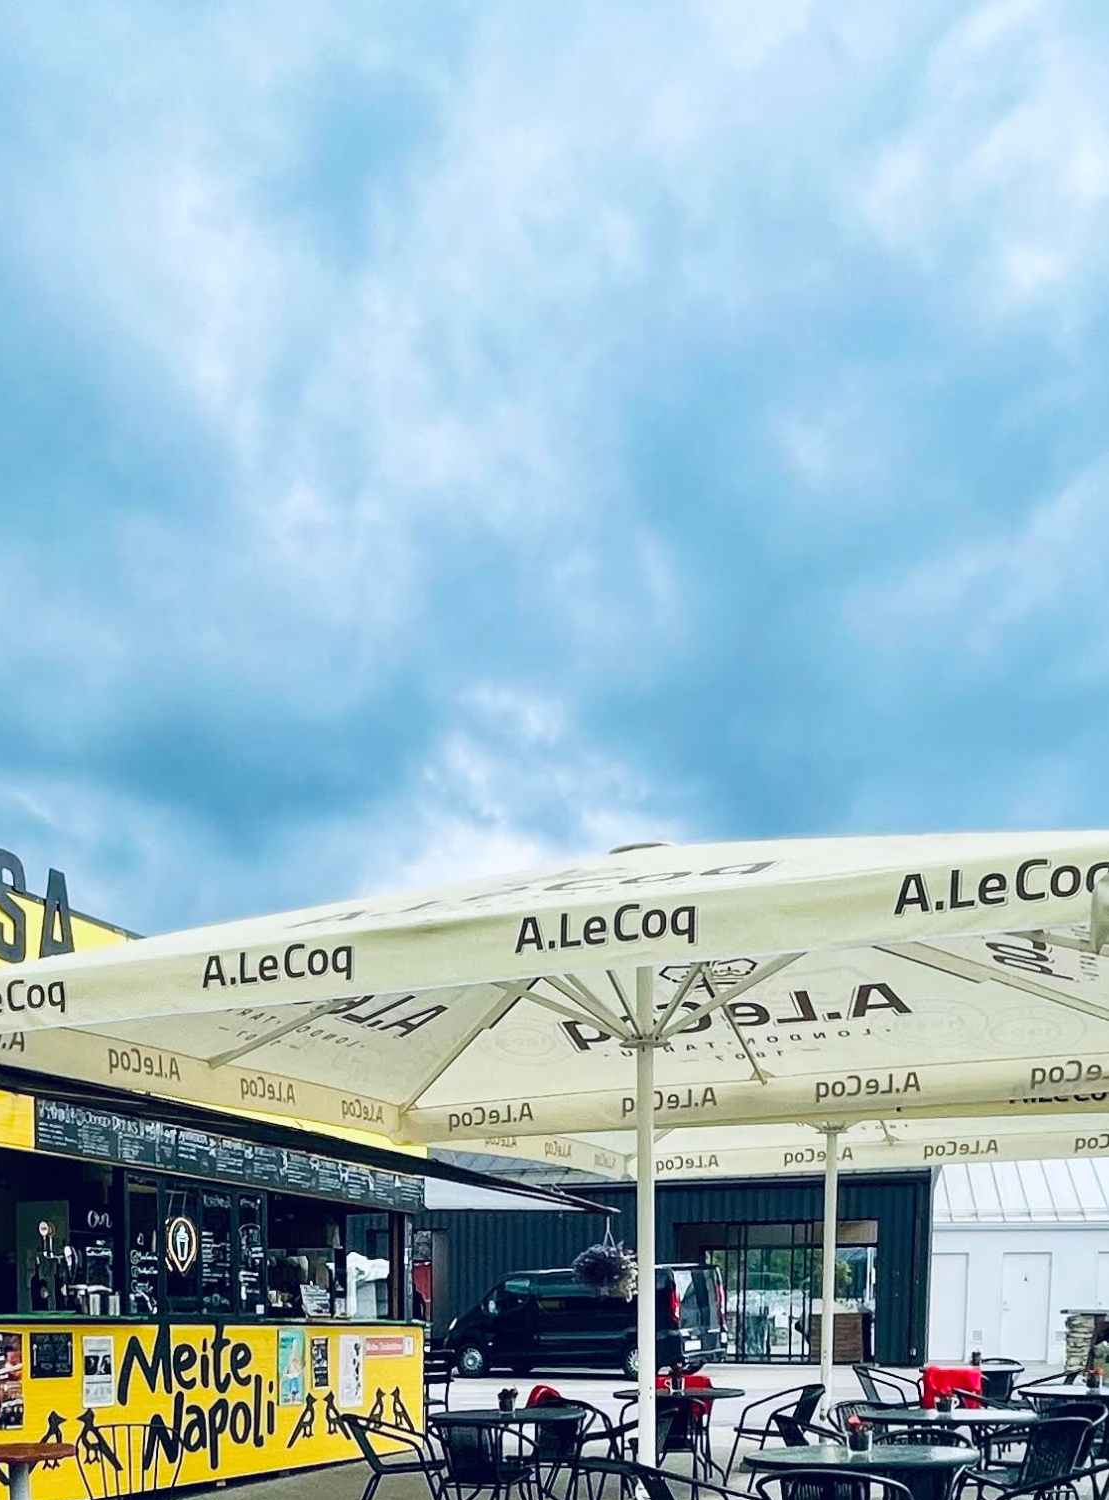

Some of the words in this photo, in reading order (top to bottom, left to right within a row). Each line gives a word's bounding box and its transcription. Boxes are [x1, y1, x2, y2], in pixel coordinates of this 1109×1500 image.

[515, 904, 697, 954] A.LeCoq
[202, 943, 353, 989] A.LeCoq
[117, 1324, 253, 1406] Meite
[143, 1374, 276, 1471] Napoli
